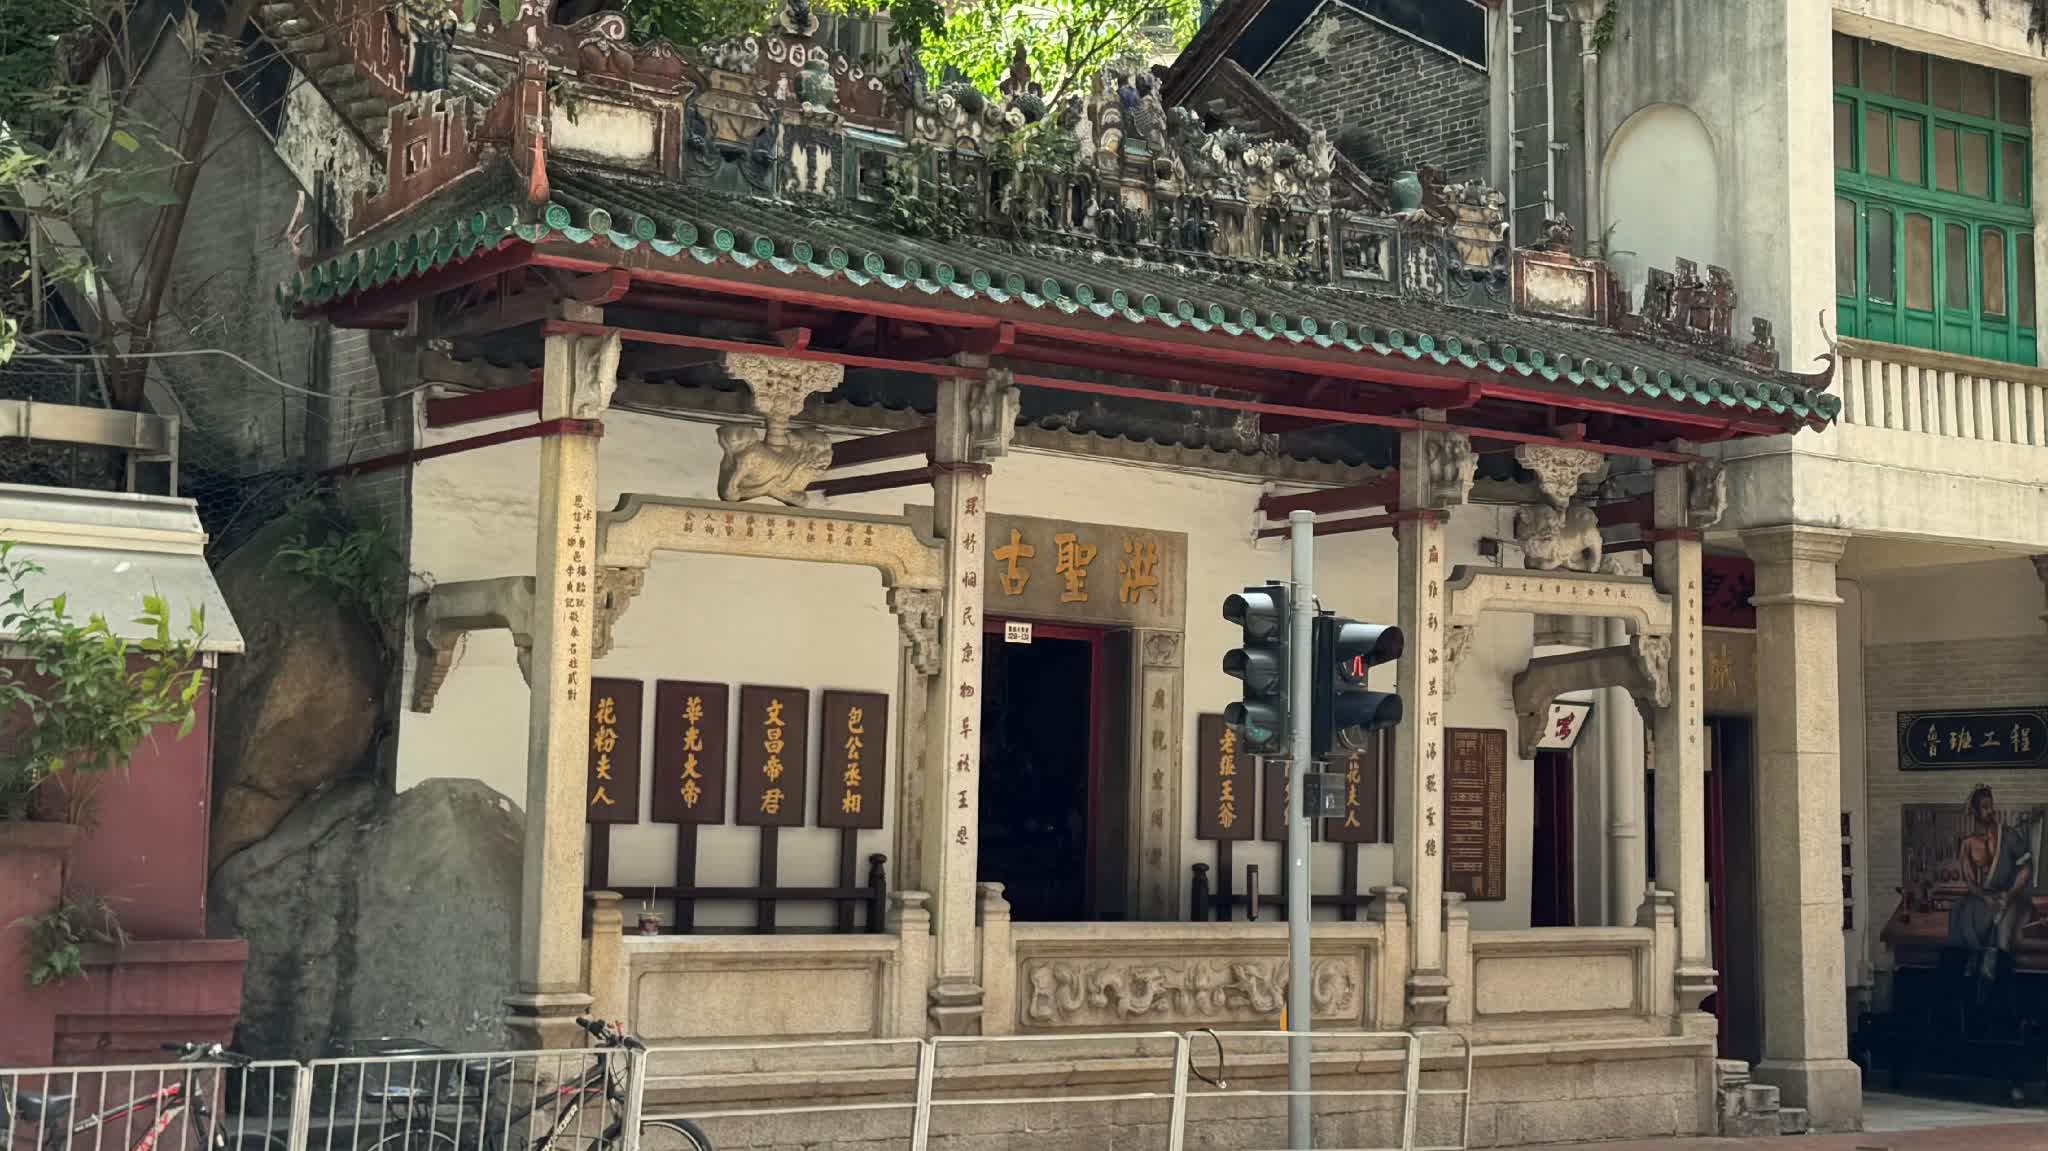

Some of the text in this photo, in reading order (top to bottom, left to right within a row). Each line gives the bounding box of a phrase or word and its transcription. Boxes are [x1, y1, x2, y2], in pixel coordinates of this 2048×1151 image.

[591, 696, 619, 806] 花粉夫人
[680, 695, 704, 809] 華光大帝
[761, 698, 787, 815] 文昌帝君
[841, 706, 865, 814] 包公丞相
